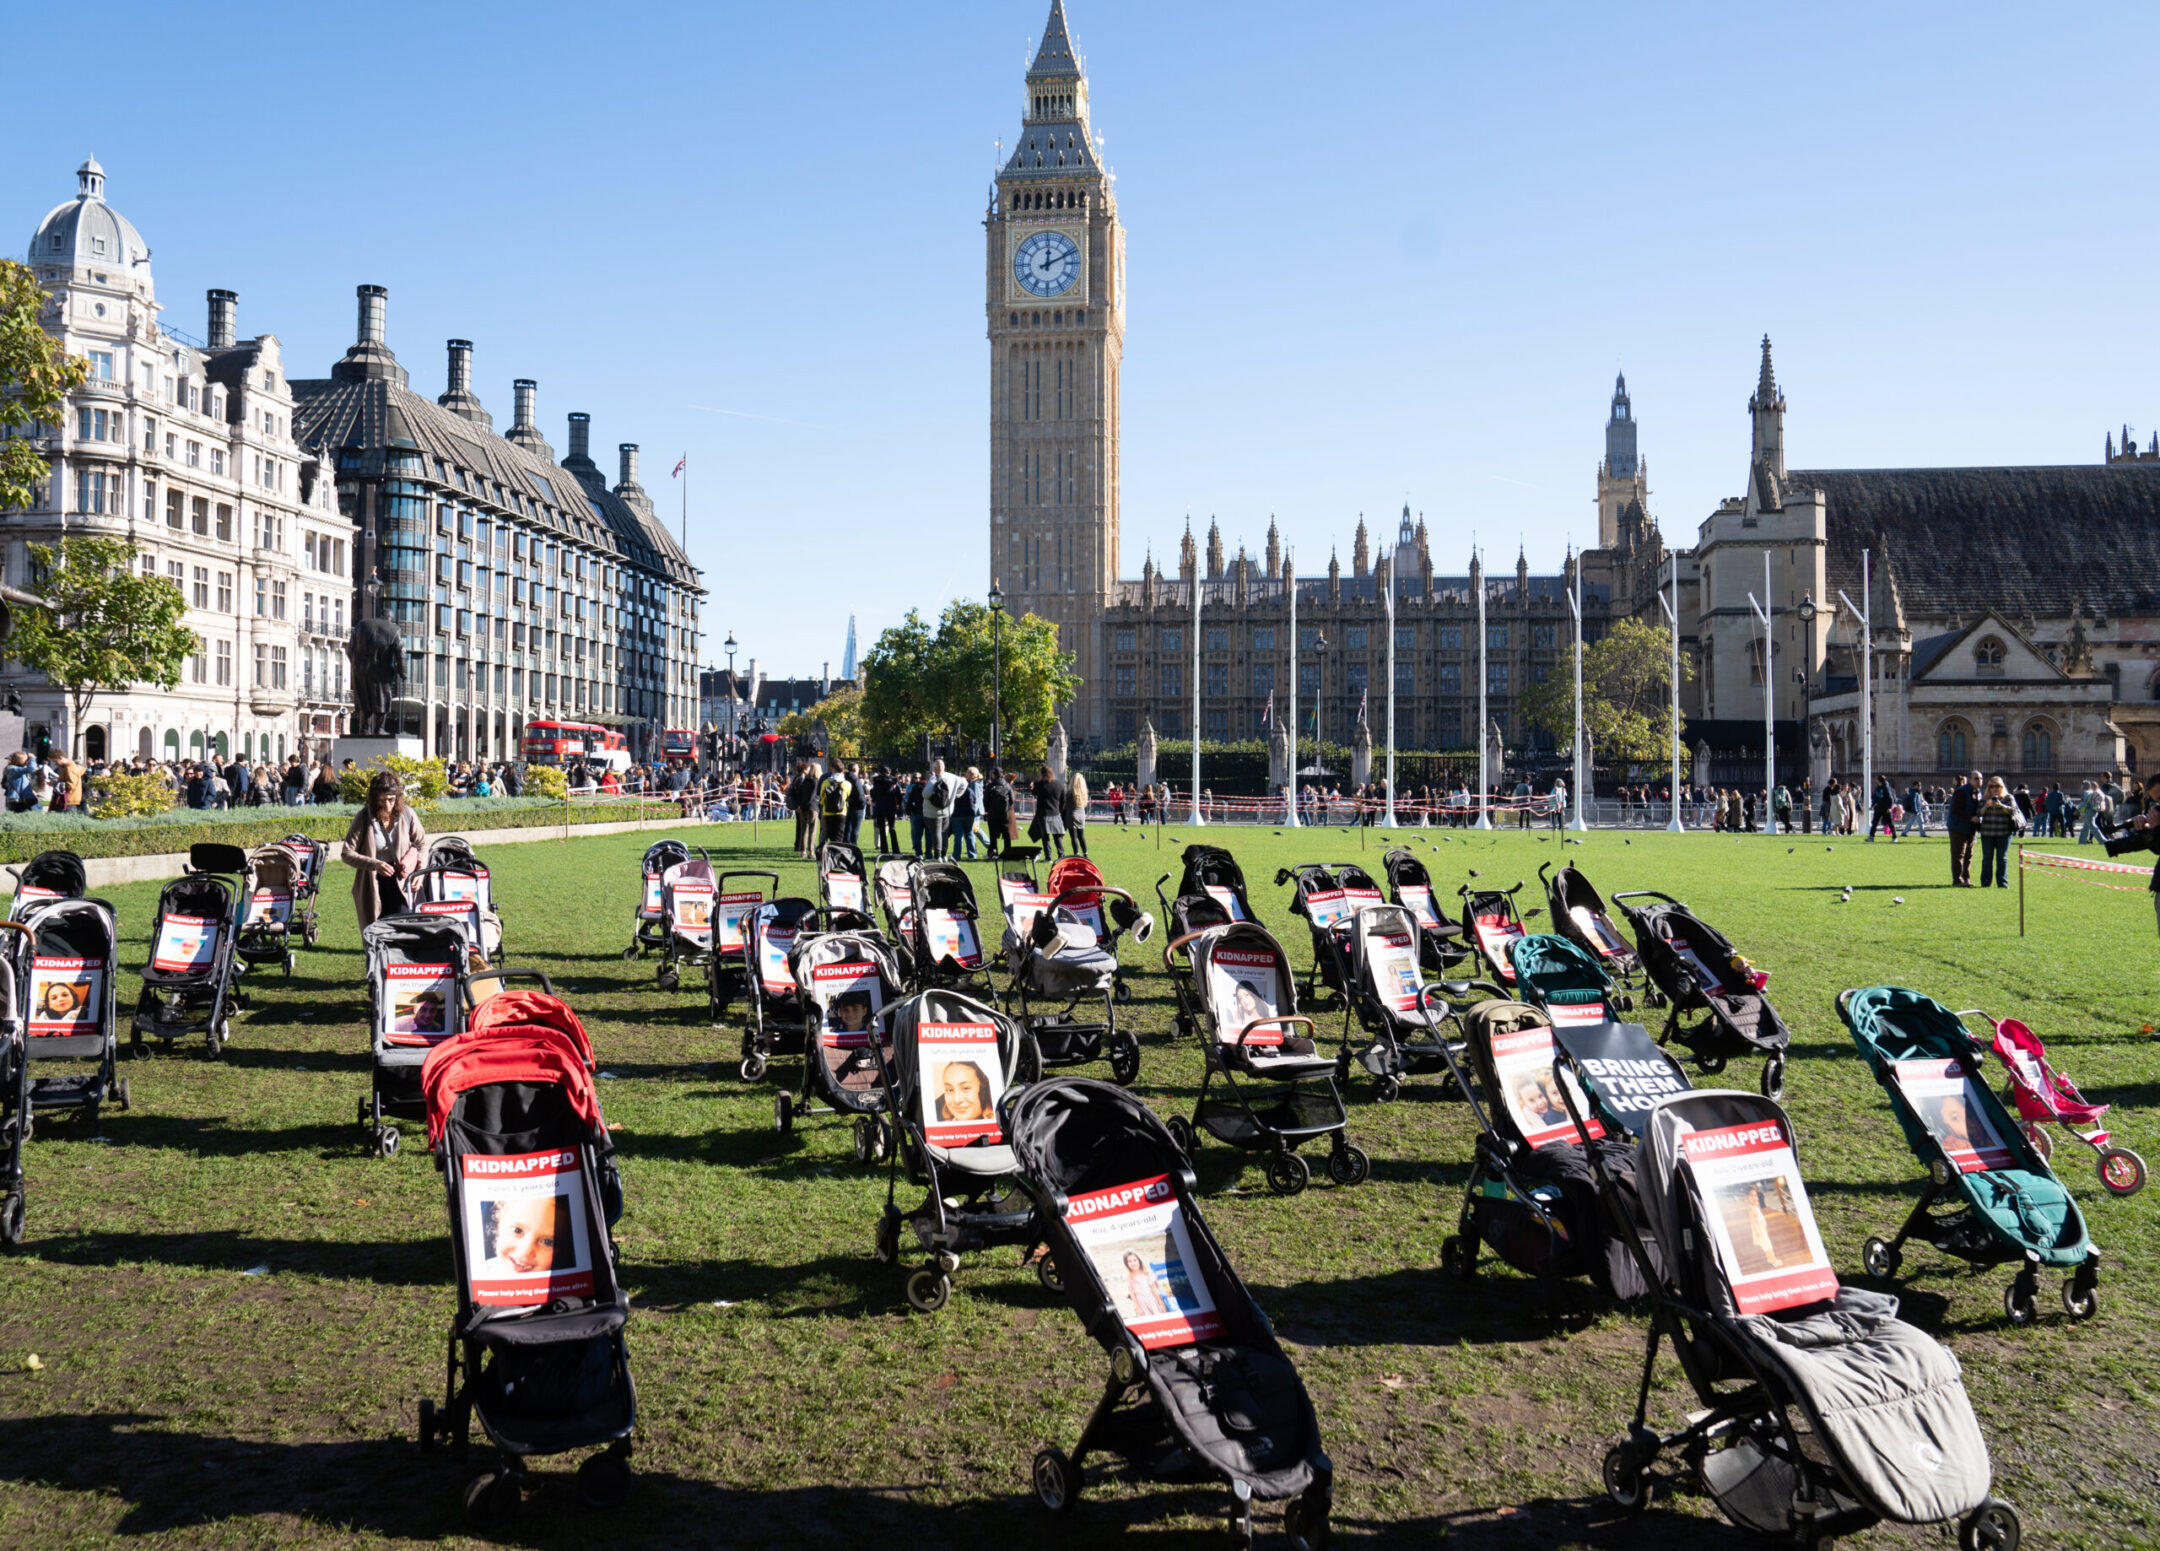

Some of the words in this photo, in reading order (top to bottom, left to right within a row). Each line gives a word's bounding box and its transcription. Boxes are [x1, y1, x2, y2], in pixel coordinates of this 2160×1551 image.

[721, 894, 762, 902] KIDNAPPED
[1308, 890, 1343, 901] KIDNAPPED
[424, 903, 473, 912] KIDNAPPED
[166, 914, 217, 925] KIDNAPPED
[35, 958, 101, 968] KIDNAPPED
[1216, 951, 1274, 963] KIDNAPPED
[389, 966, 453, 976] KIDNAPPED
[816, 965, 877, 977] KIDNAPPED
[921, 1027, 994, 1039] KIDNAPPED
[1493, 1032, 1552, 1052] KIDNAPPED
[1581, 1058, 1674, 1077] BRING
[1596, 1076, 1684, 1095] THEM
[1608, 1094, 1672, 1112] HO
[1686, 1125, 1783, 1153] KIDNAPPED
[468, 1151, 575, 1174] KIDNAPPED
[1064, 1181, 1170, 1218] KIDNAPPED
[477, 1289, 499, 1297] Please
[500, 1288, 515, 1298] help
[515, 1287, 533, 1297] bring
[534, 1286, 550, 1295] them
[552, 1285, 570, 1293] home
[1740, 1295, 1760, 1304] Please
[1759, 1292, 1772, 1301] help
[1772, 1289, 1789, 1298] bring
[1787, 1286, 1802, 1294] them
[1802, 1283, 1819, 1292] home
[1141, 1331, 1156, 1340] help
[1155, 1329, 1173, 1338] bring
[1172, 1327, 1187, 1335] them
[1187, 1325, 1204, 1333] home
